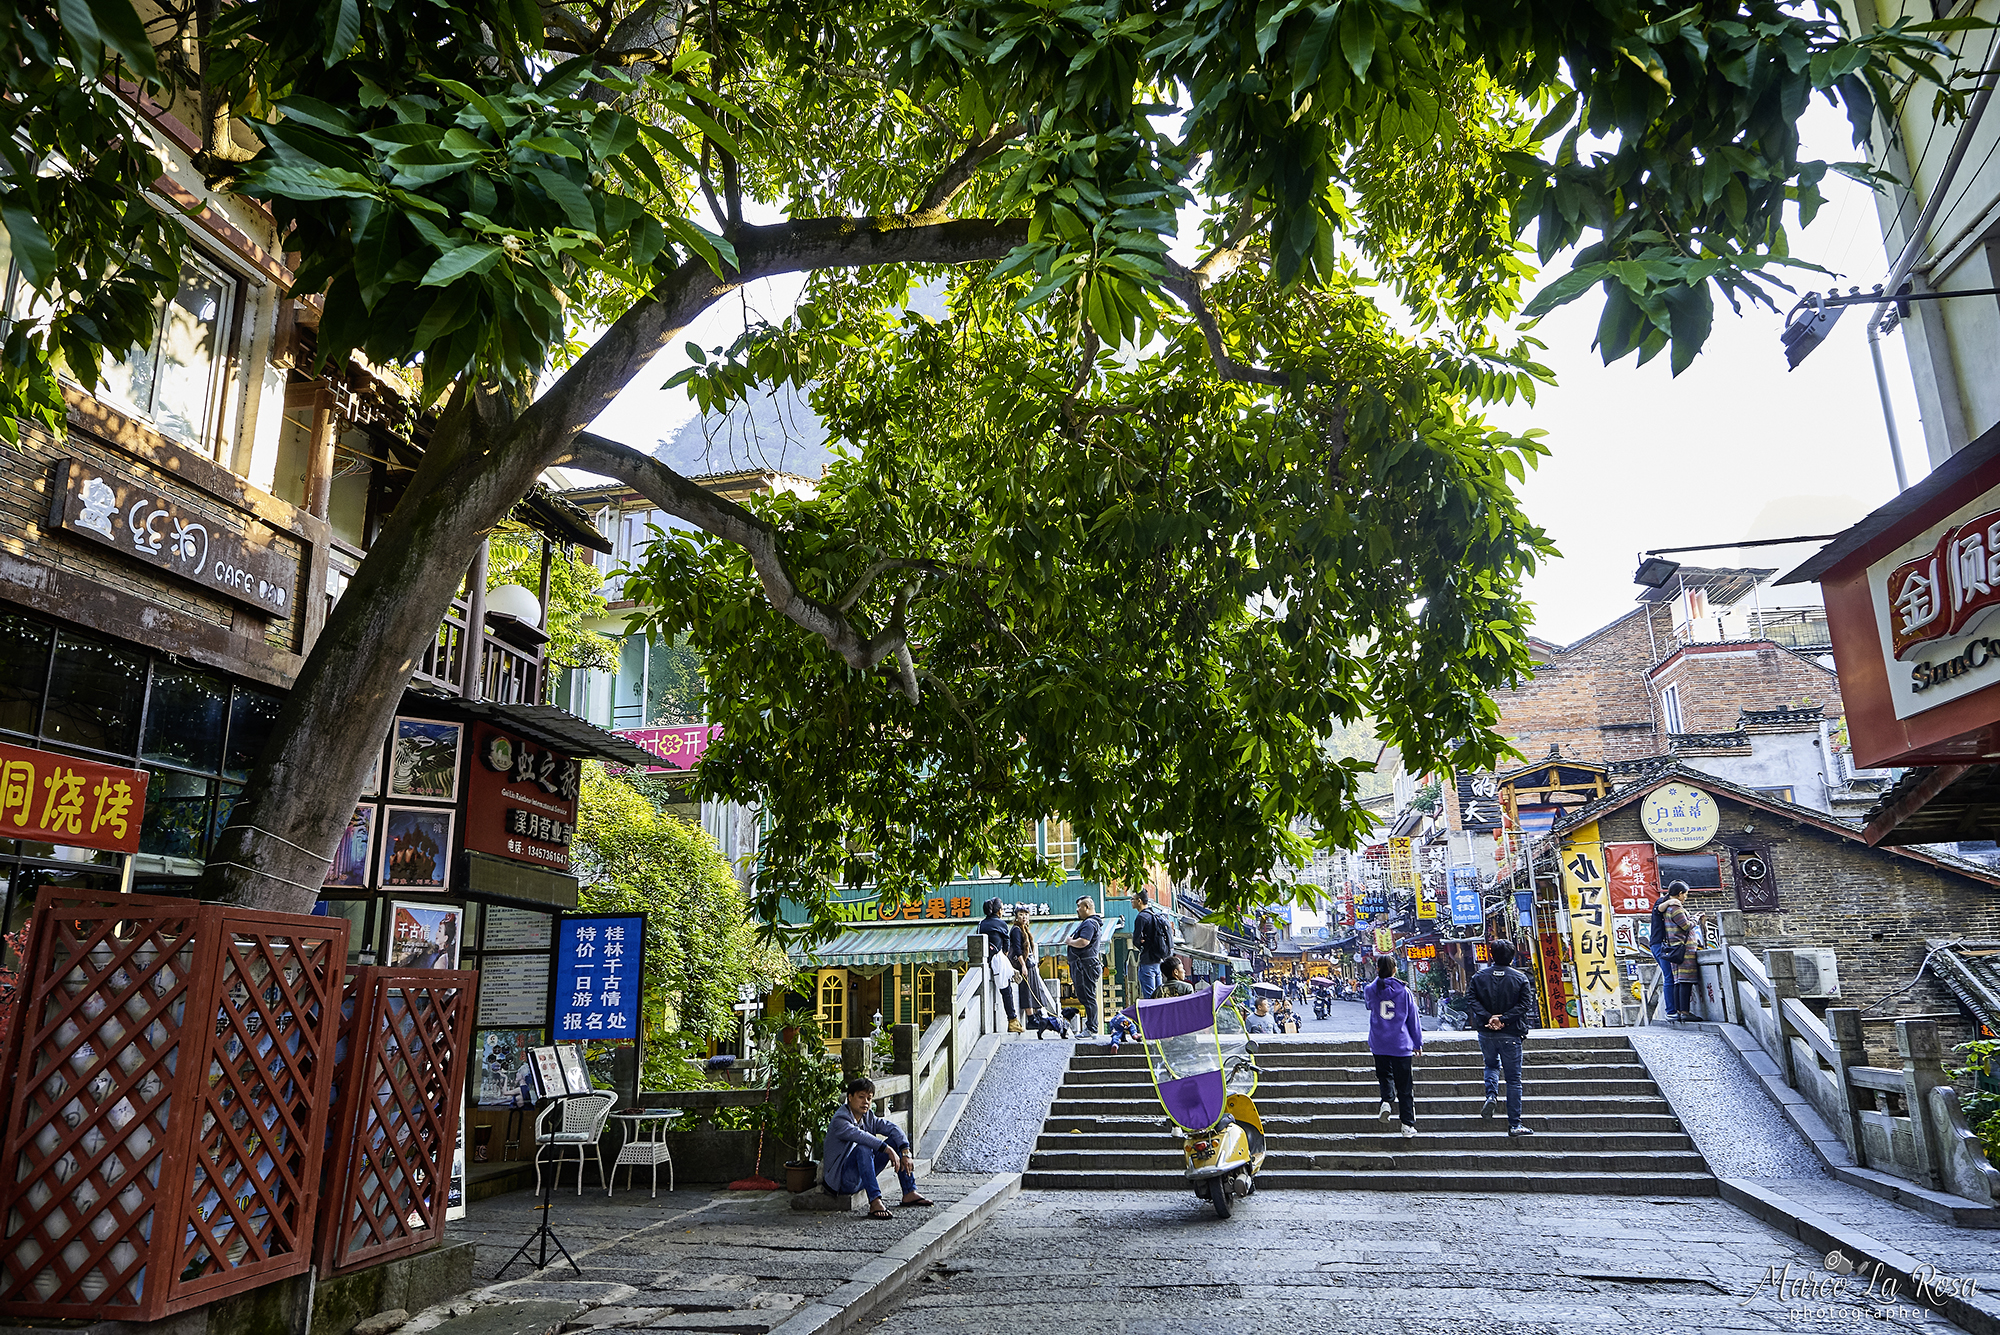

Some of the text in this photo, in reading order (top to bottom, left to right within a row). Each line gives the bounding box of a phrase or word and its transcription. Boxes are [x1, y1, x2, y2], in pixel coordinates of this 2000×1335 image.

[214, 560, 287, 608] CAFE BAR
[902, 896, 972, 920] 芒果帮
[1567, 853, 1615, 993] 小马的天
[397, 922, 431, 941] 千古情
[572, 926, 597, 1007] 特价一日游
[600, 925, 625, 1007] 桂林千古情
[563, 1012, 627, 1030] 报名处
[1380, 1000, 1395, 1020] C
